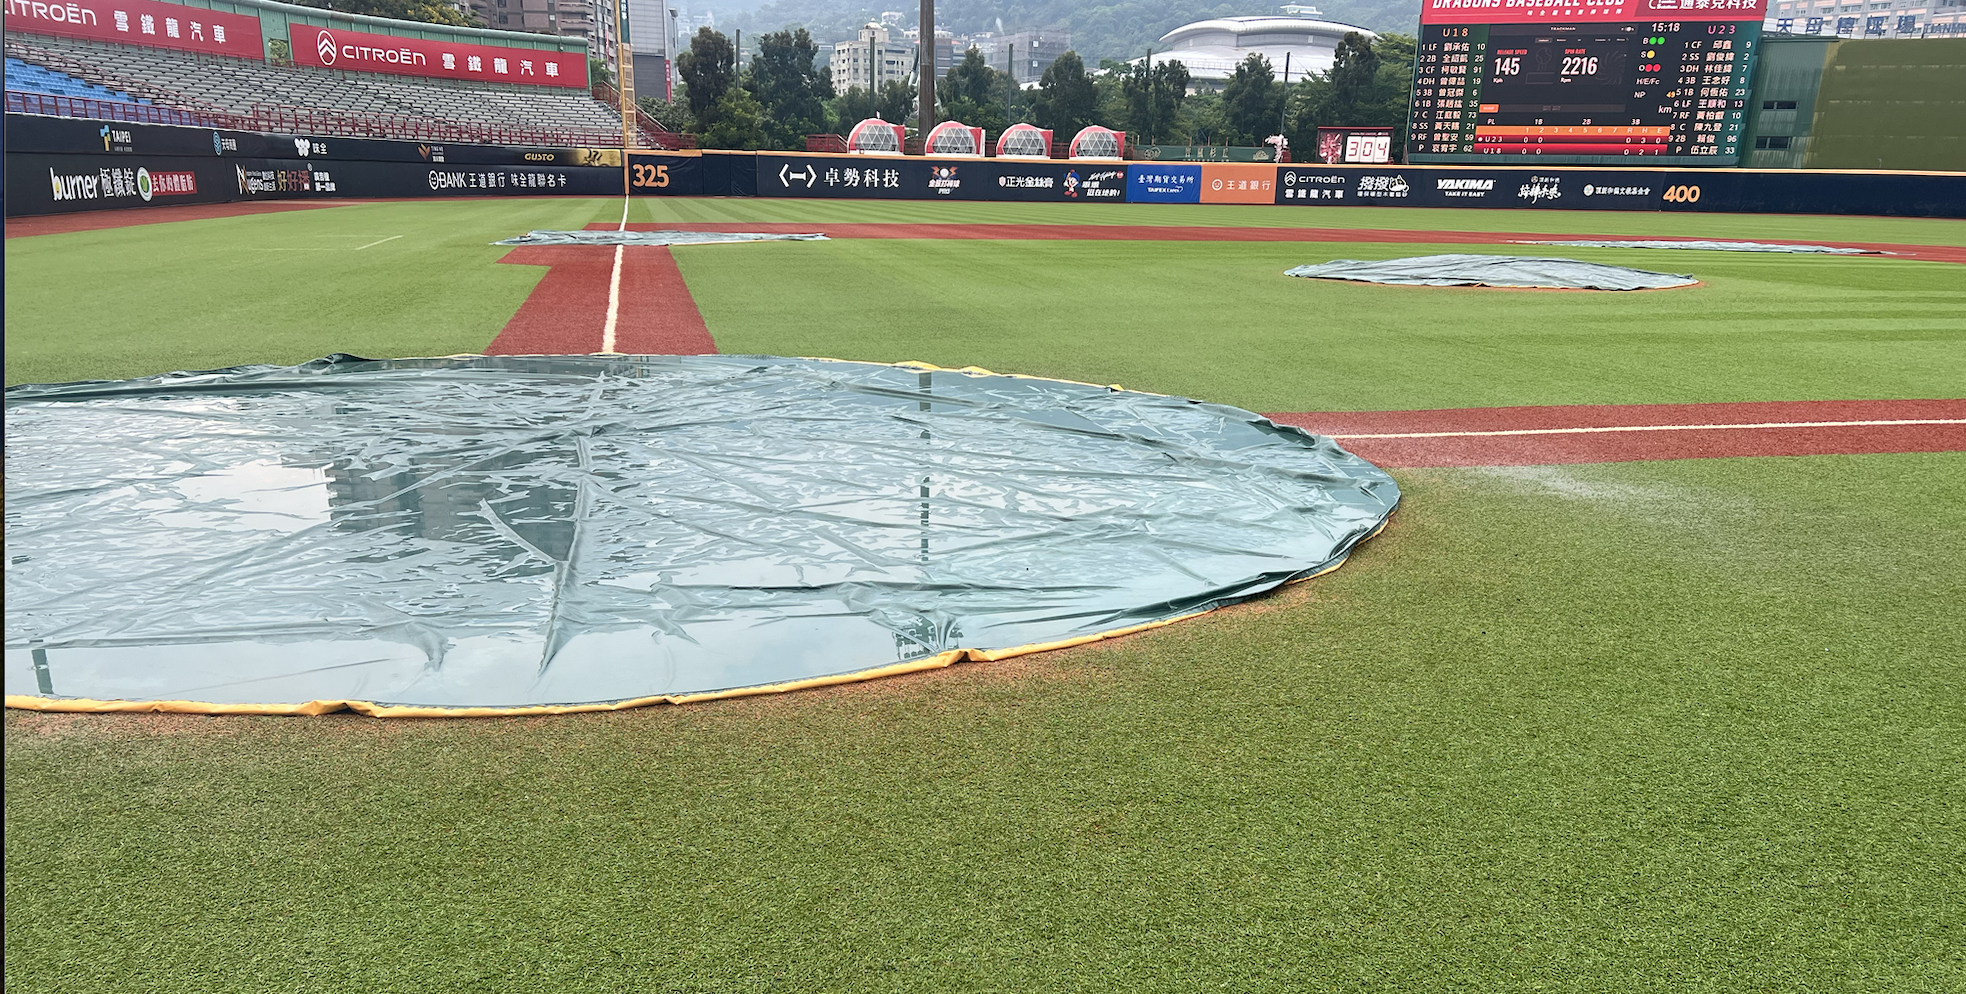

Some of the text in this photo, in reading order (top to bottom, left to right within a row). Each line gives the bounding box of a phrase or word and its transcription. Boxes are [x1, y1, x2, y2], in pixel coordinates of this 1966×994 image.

[5, 0, 97, 26] ITROËN
[114, 10, 226, 44] 雪鐵龍汽車
[1652, 22, 1680, 32] 15:18
[442, 53, 560, 78] 雪鐵龍汽車
[1494, 57, 1520, 76] 145
[1560, 57, 1598, 75] 2216
[1658, 105, 1672, 113] km
[112, 130, 132, 143] TAIPEI
[524, 153, 555, 161] GUSTO
[1349, 142, 1387, 156] 304
[50, 167, 99, 202] burner
[469, 173, 505, 188] 王道銀行
[510, 173, 567, 188] 味全龍聯名卡
[632, 164, 670, 188] 325
[824, 168, 900, 188] 卓勢科技
[1226, 180, 1271, 190] 王道銀行
[1436, 179, 1494, 190] YAKIMA
[1663, 185, 1700, 203] 400
